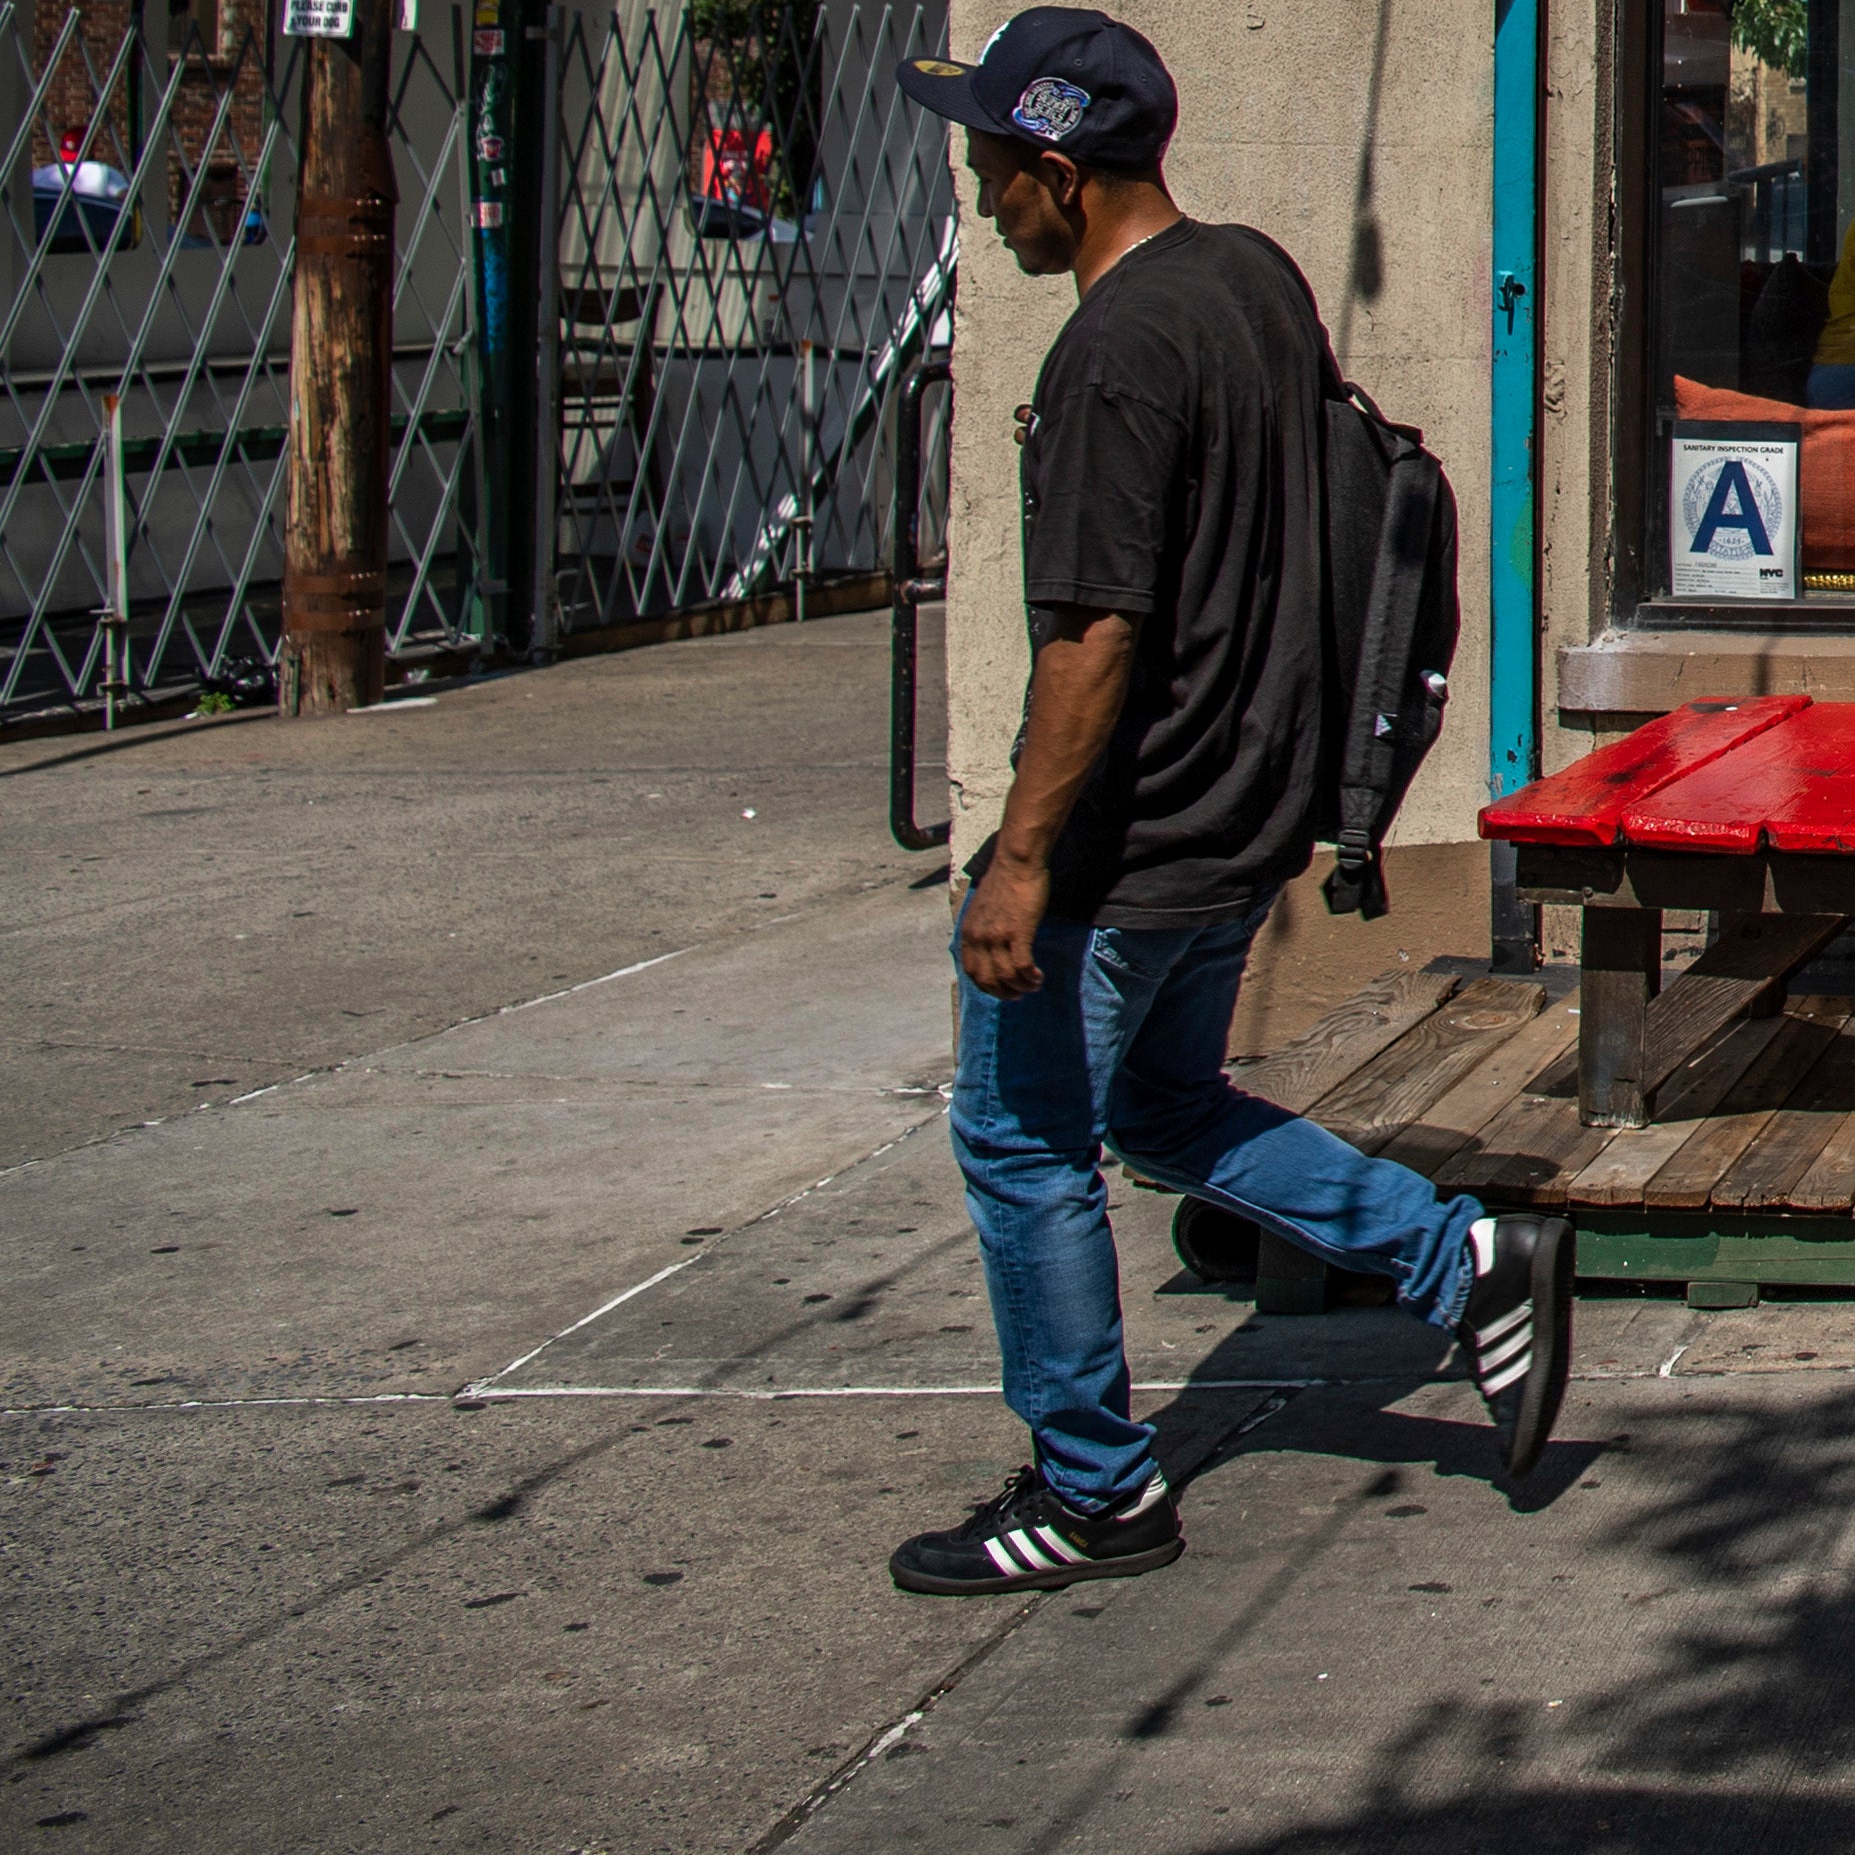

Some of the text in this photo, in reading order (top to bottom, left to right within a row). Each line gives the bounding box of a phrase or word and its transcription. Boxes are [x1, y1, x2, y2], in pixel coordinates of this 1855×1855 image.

[1683, 444, 1715, 452] SANITARY
[1760, 446, 1784, 454] GRADE
[1689, 461, 1775, 556] A
[1760, 569, 1783, 577] NYC
